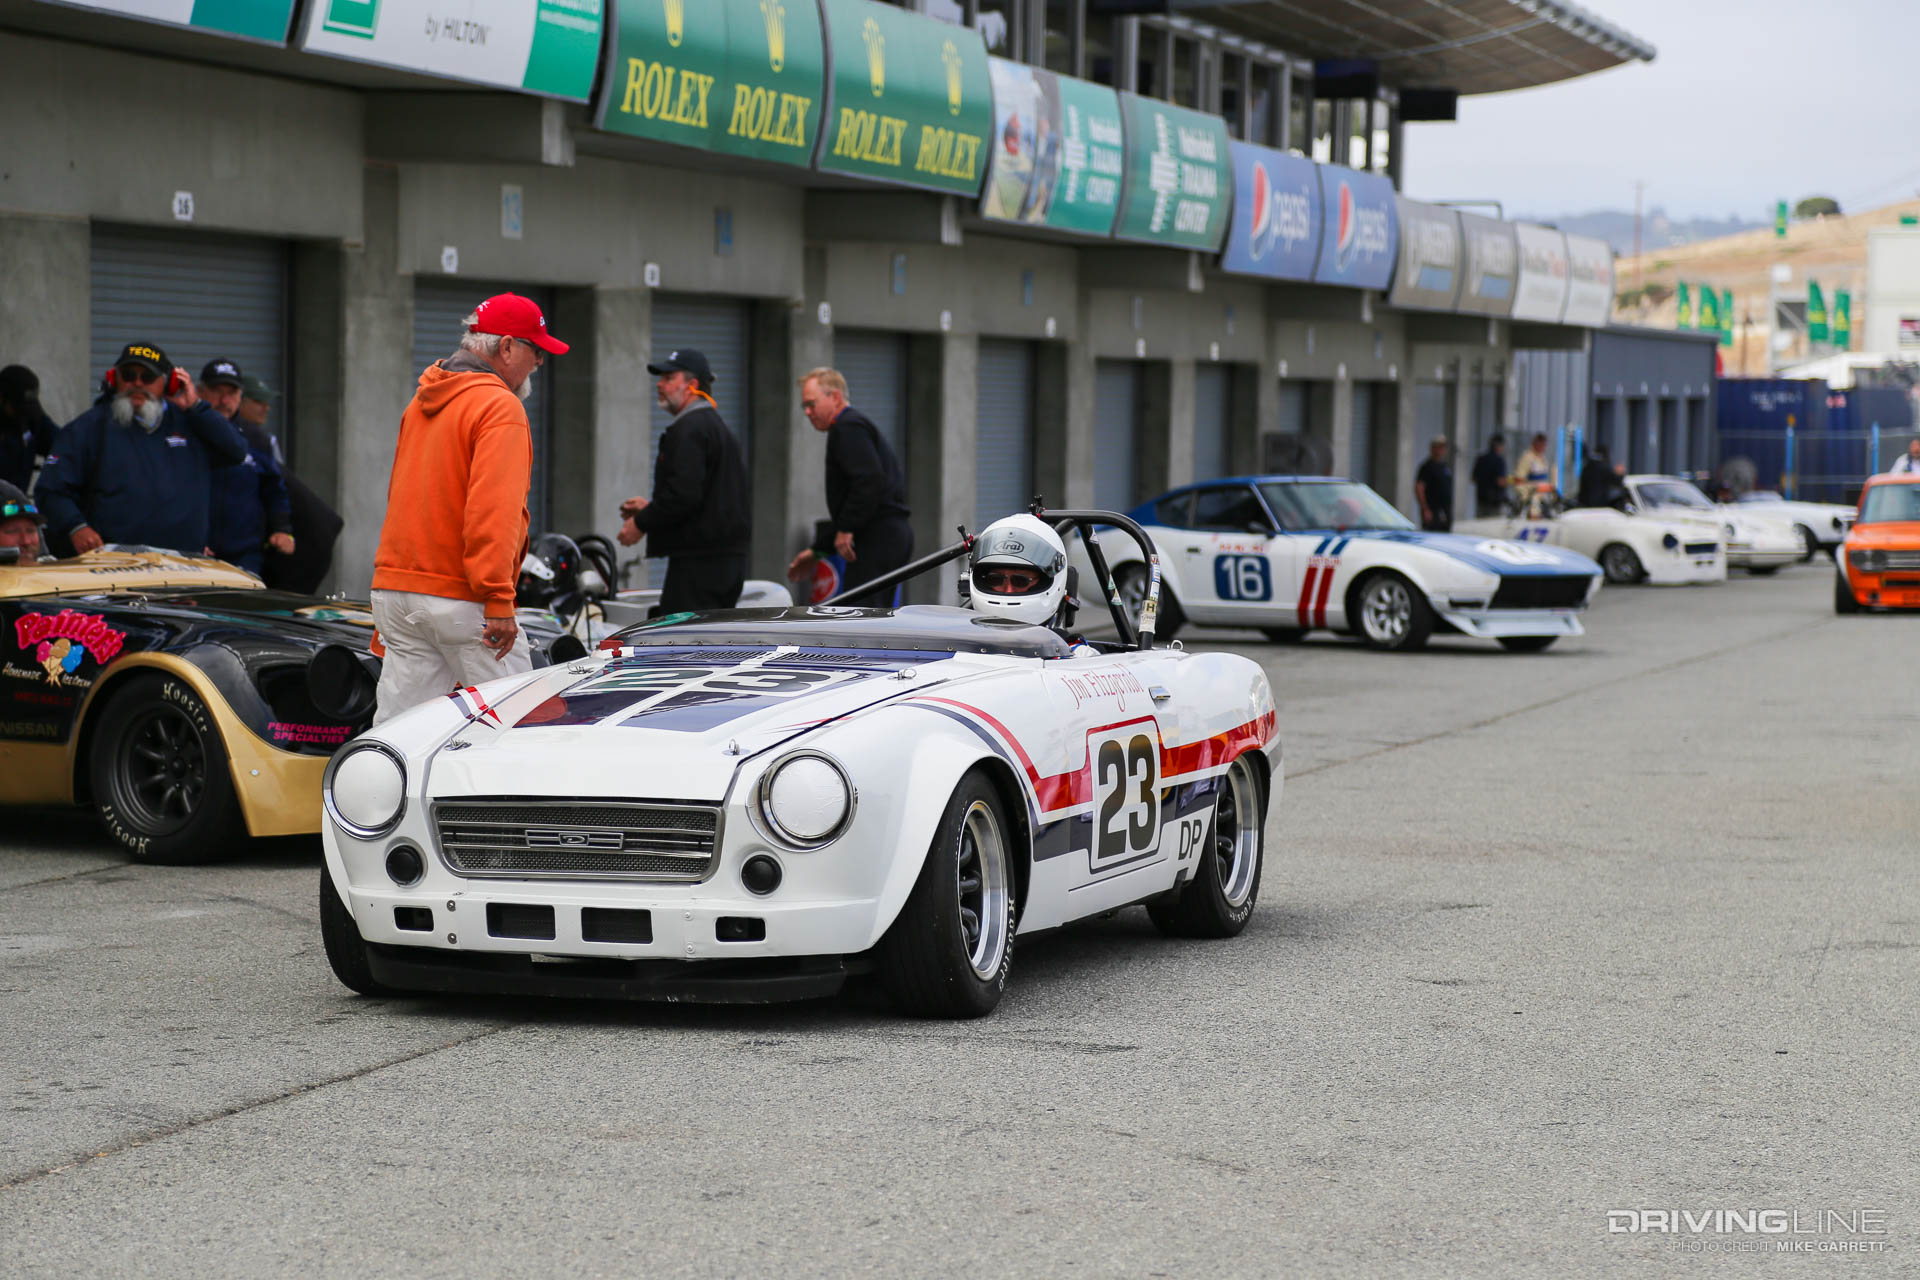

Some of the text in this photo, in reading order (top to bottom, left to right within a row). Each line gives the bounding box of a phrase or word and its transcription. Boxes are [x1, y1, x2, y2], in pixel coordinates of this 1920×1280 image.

[424, 15, 488, 46] by HILTON
[620, 57, 714, 128] ROLEX
[727, 83, 811, 148] ROLEX
[833, 107, 907, 166] ROLEX
[915, 125, 981, 181] ROLEX
[1268, 184, 1310, 254] pepsi
[1350, 202, 1388, 264] pepsi
[129, 346, 160, 361] TECH
[1000, 541, 1021, 551] Arai
[1221, 556, 1264, 599] 16
[580, 668, 832, 693] 23
[0, 721, 57, 737] NISSAN
[162, 682, 208, 733] Hoosier
[267, 721, 352, 735] PERFORMANCE
[273, 731, 345, 744] SPECIALTIES
[1097, 734, 1157, 860] 23
[102, 804, 150, 854] Hoosier
[1178, 819, 1202, 861] DP
